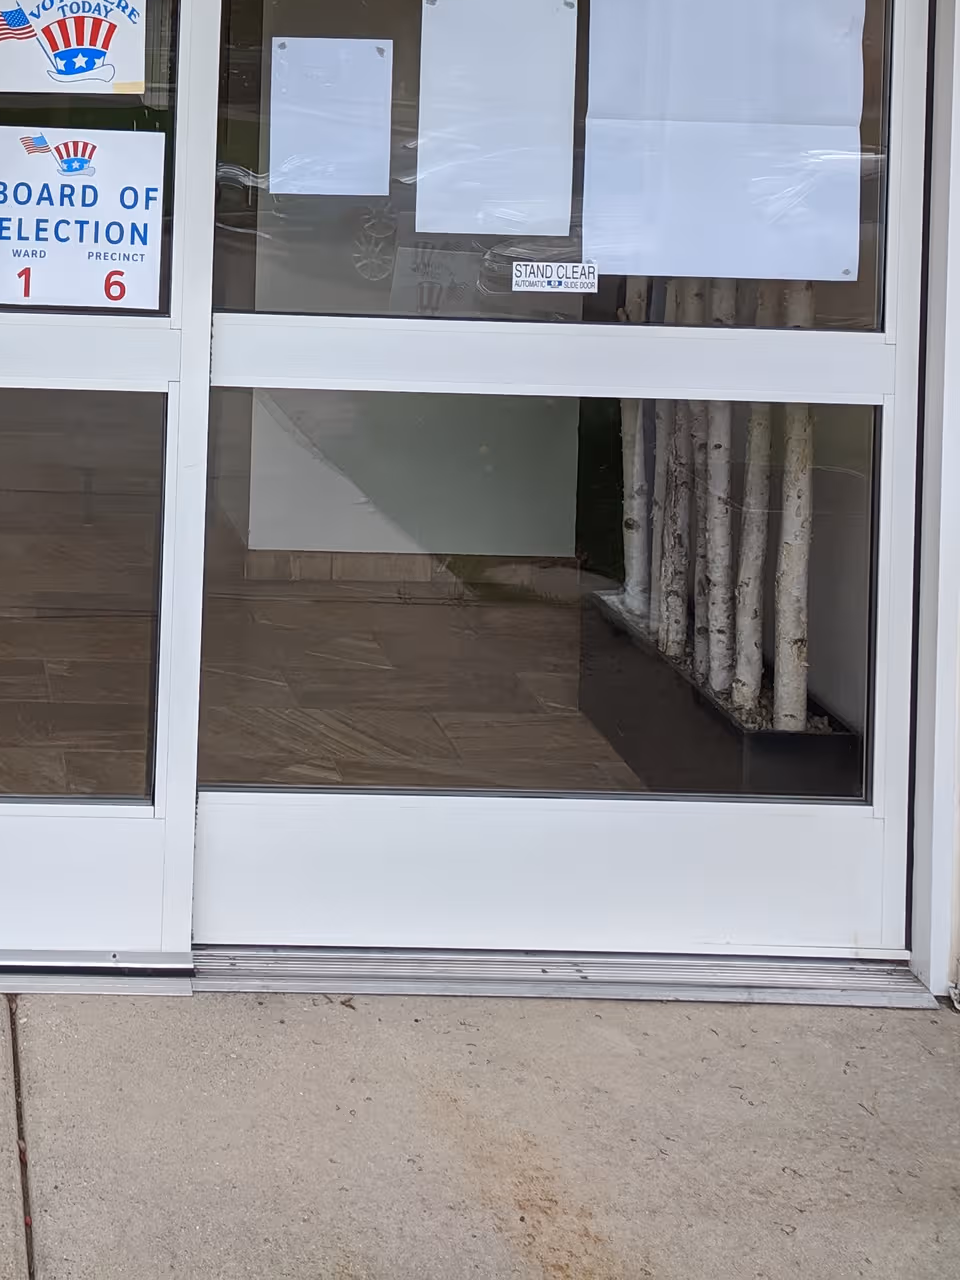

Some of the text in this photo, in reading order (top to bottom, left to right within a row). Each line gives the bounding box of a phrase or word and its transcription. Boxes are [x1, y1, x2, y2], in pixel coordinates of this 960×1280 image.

[57, 0, 115, 19] TODAY
[119, 186, 159, 210] OF
[12, 249, 146, 262] WARD PRECINCT
[514, 263, 596, 280] STAND CLEAR
[16, 267, 127, 301] 1 6
[514, 280, 546, 288] AUTOMATIC
[563, 281, 579, 289] SLIDE
